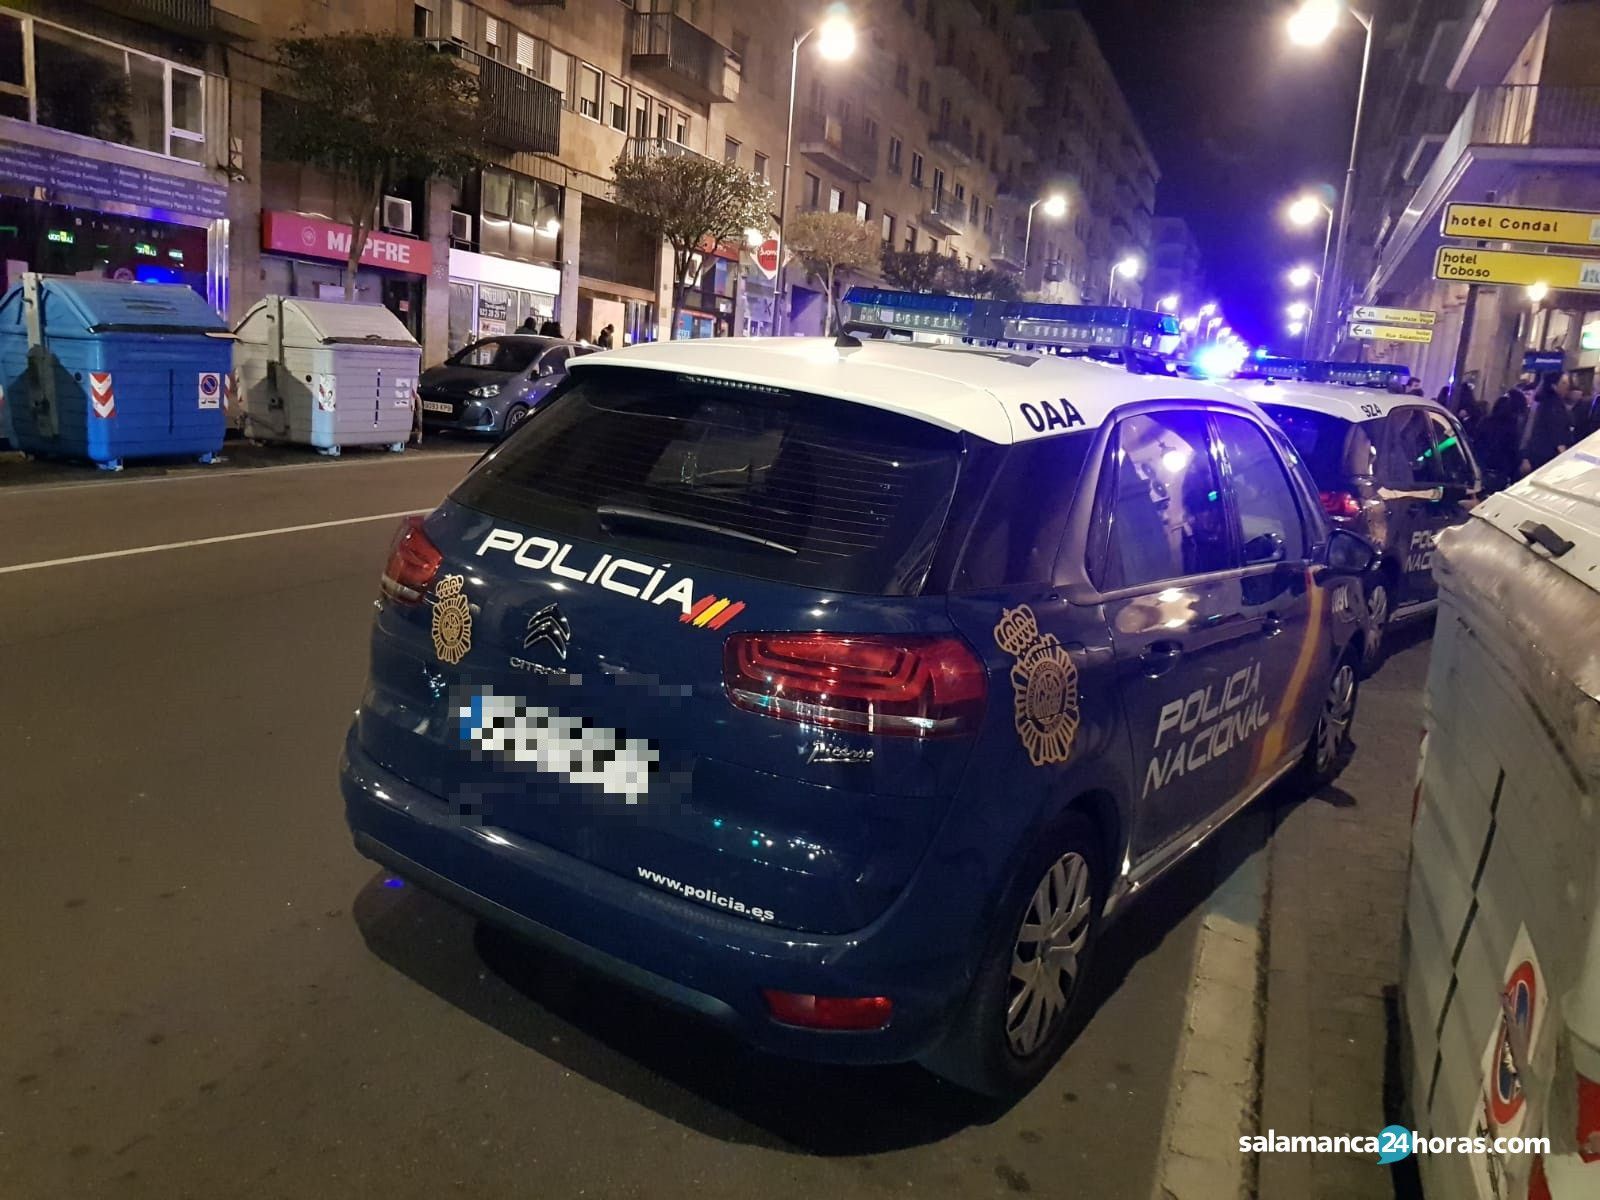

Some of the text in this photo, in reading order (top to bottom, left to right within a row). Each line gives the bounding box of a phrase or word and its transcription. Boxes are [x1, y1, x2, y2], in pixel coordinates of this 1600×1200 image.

[1451, 214, 1559, 233] hotel Condal
[1442, 252, 1478, 265] hotel
[1442, 264, 1491, 278] Toboso
[476, 527, 694, 615] POLICÍA
[1142, 696, 1270, 800] NACIONAL
[637, 866, 775, 921] www.policia.es
